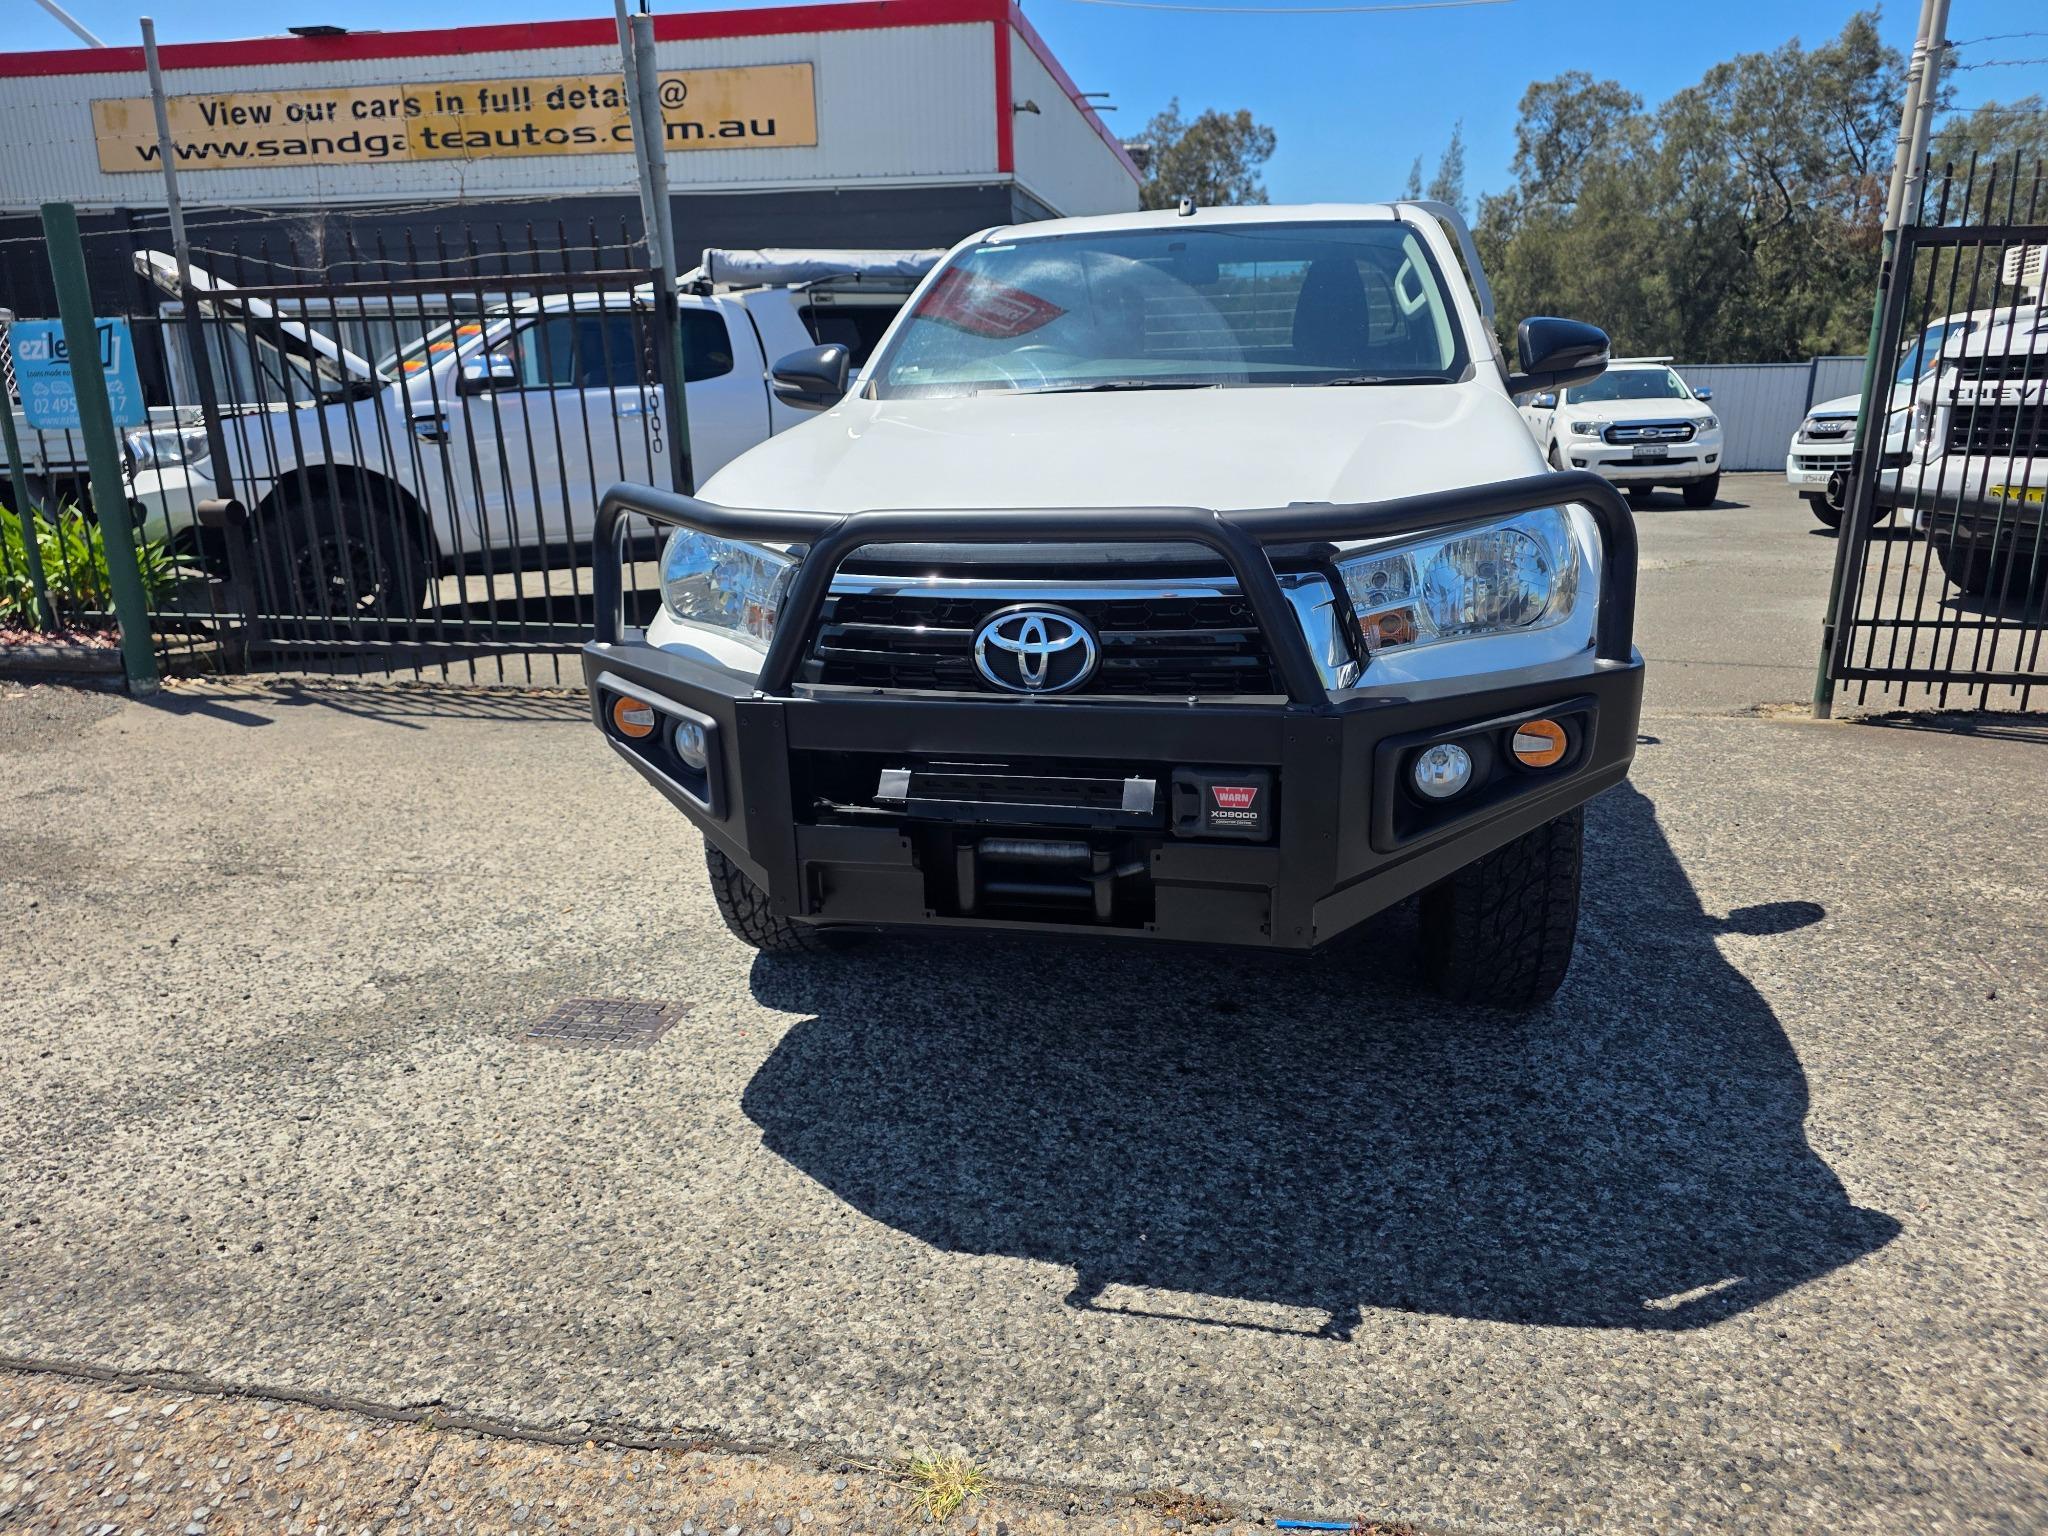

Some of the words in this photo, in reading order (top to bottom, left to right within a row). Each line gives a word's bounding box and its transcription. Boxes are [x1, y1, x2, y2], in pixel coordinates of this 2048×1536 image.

[199, 101, 271, 126] View
[286, 101, 337, 122] our
[351, 96, 421, 119] cars
[435, 89, 464, 114] in
[477, 86, 531, 115] full
[659, 78, 687, 109] @
[136, 118, 775, 161] www.sandgateautos.cm.au
[19, 332, 69, 360] ezile
[1949, 387, 2048, 399] CHEV
[34, 398, 48, 414] 02
[52, 397, 77, 413] 495
[1219, 793, 1249, 802] WARN
[1211, 810, 1258, 819] XD9000
